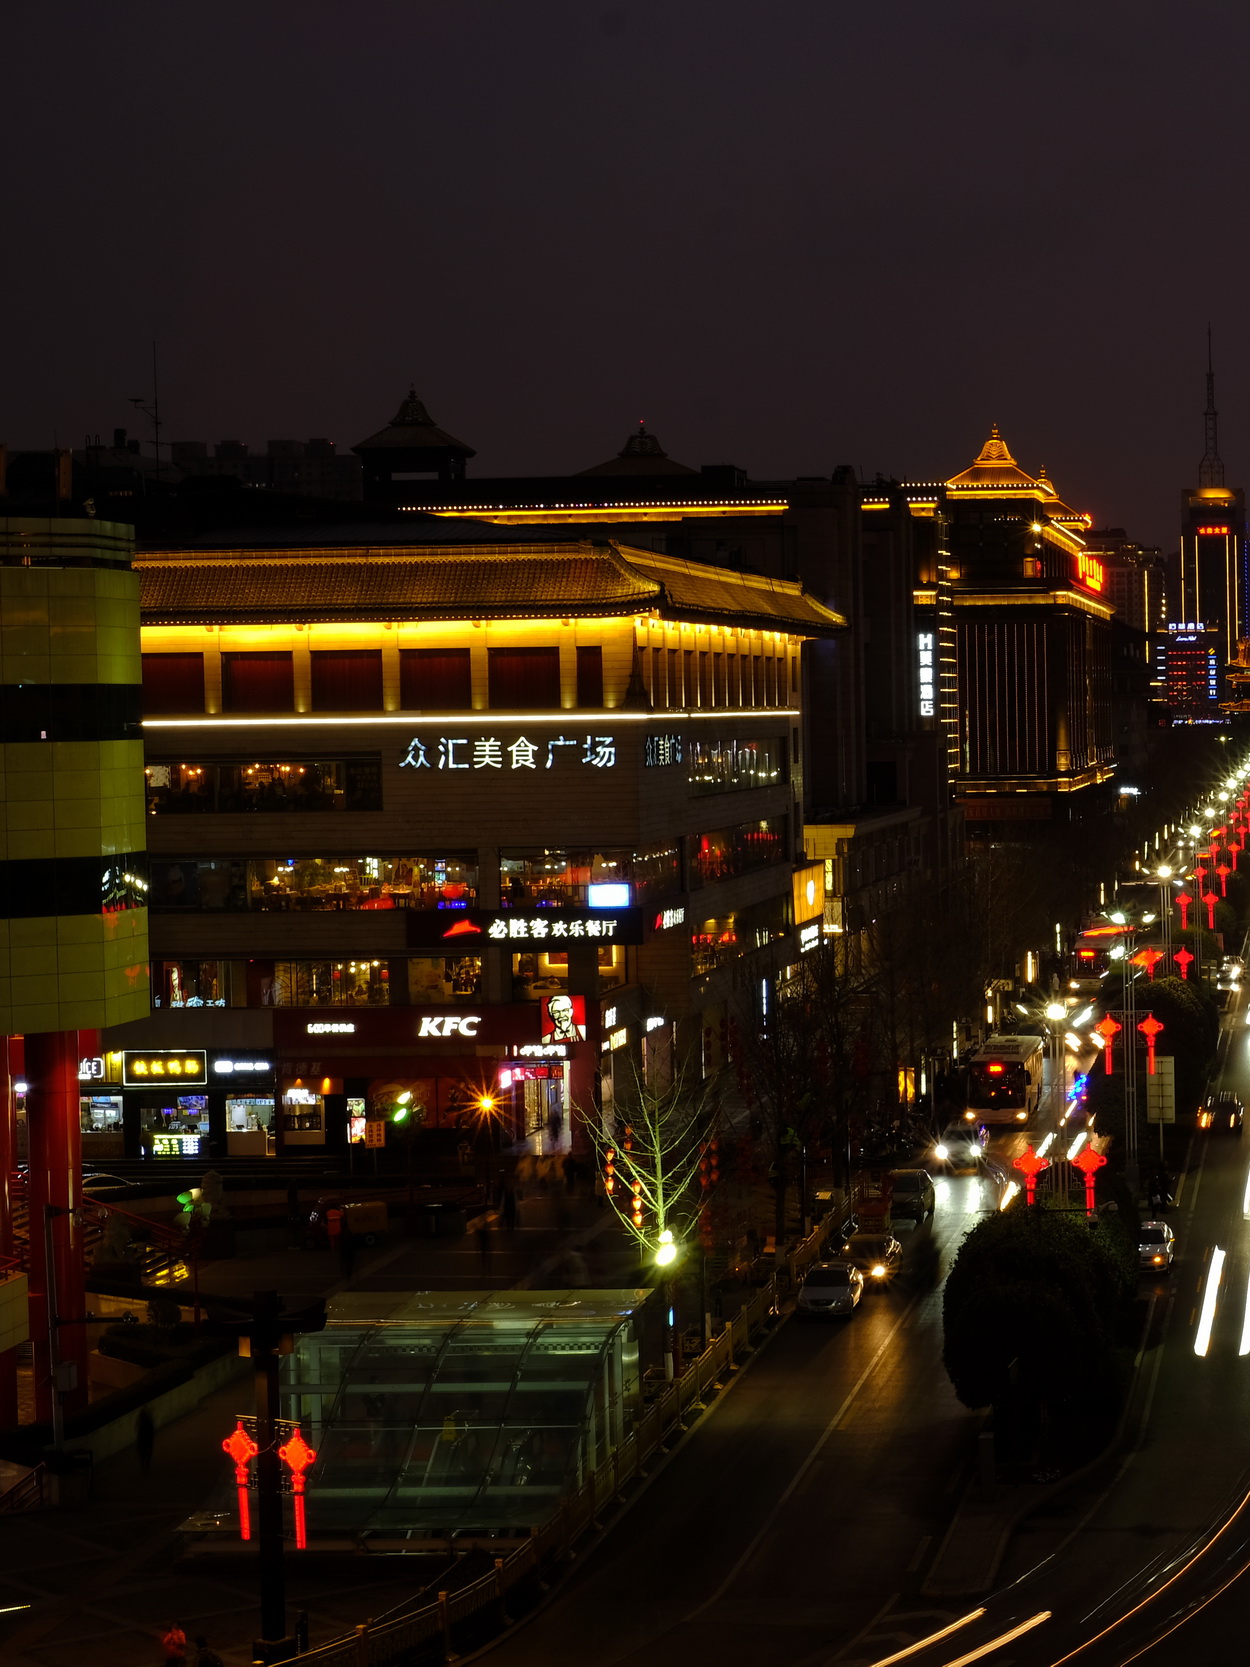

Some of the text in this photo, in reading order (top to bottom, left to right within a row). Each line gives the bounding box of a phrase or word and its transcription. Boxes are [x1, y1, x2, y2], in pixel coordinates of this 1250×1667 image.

[398, 735, 616, 769] 众汇美食广场
[645, 734, 683, 767] 众汇美食广场
[488, 918, 617, 939] 必胜客欢乐餐厅
[418, 1016, 480, 1037] KFC
[282, 1061, 323, 1075] 肯德基
